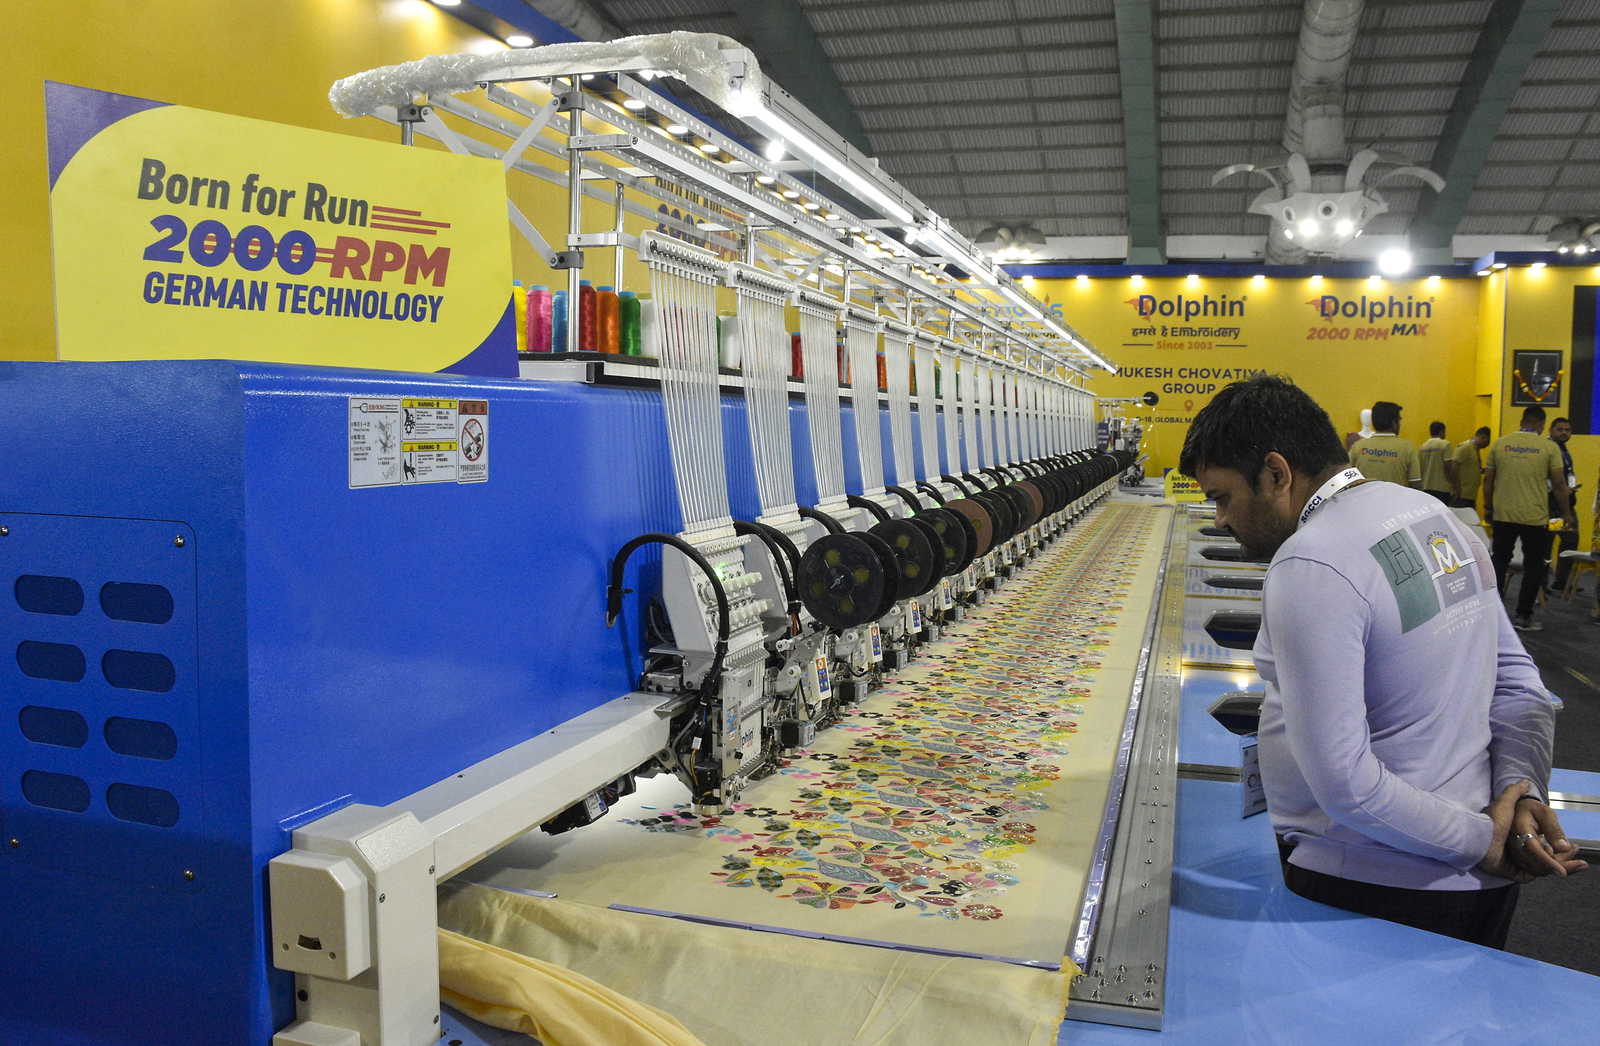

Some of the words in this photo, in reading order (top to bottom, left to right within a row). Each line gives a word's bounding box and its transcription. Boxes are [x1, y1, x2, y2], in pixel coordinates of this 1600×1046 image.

[137, 158, 230, 208] Born
[241, 173, 296, 217] for
[303, 182, 368, 227] Run
[143, 214, 316, 275] 2000
[329, 236, 451, 288] RPM
[143, 271, 268, 312] GERMAN
[276, 282, 443, 323] TECHNOLOGY
[1138, 294, 1245, 321] Dolphin
[1320, 295, 1432, 324] Dolphin
[1171, 327, 1240, 340] Embroidery
[1306, 327, 1351, 340] 2000
[1354, 327, 1390, 340] RPM
[1391, 323, 1429, 336] MAX
[1156, 341, 1185, 350] Since
[1162, 383, 1216, 394] GROUP
